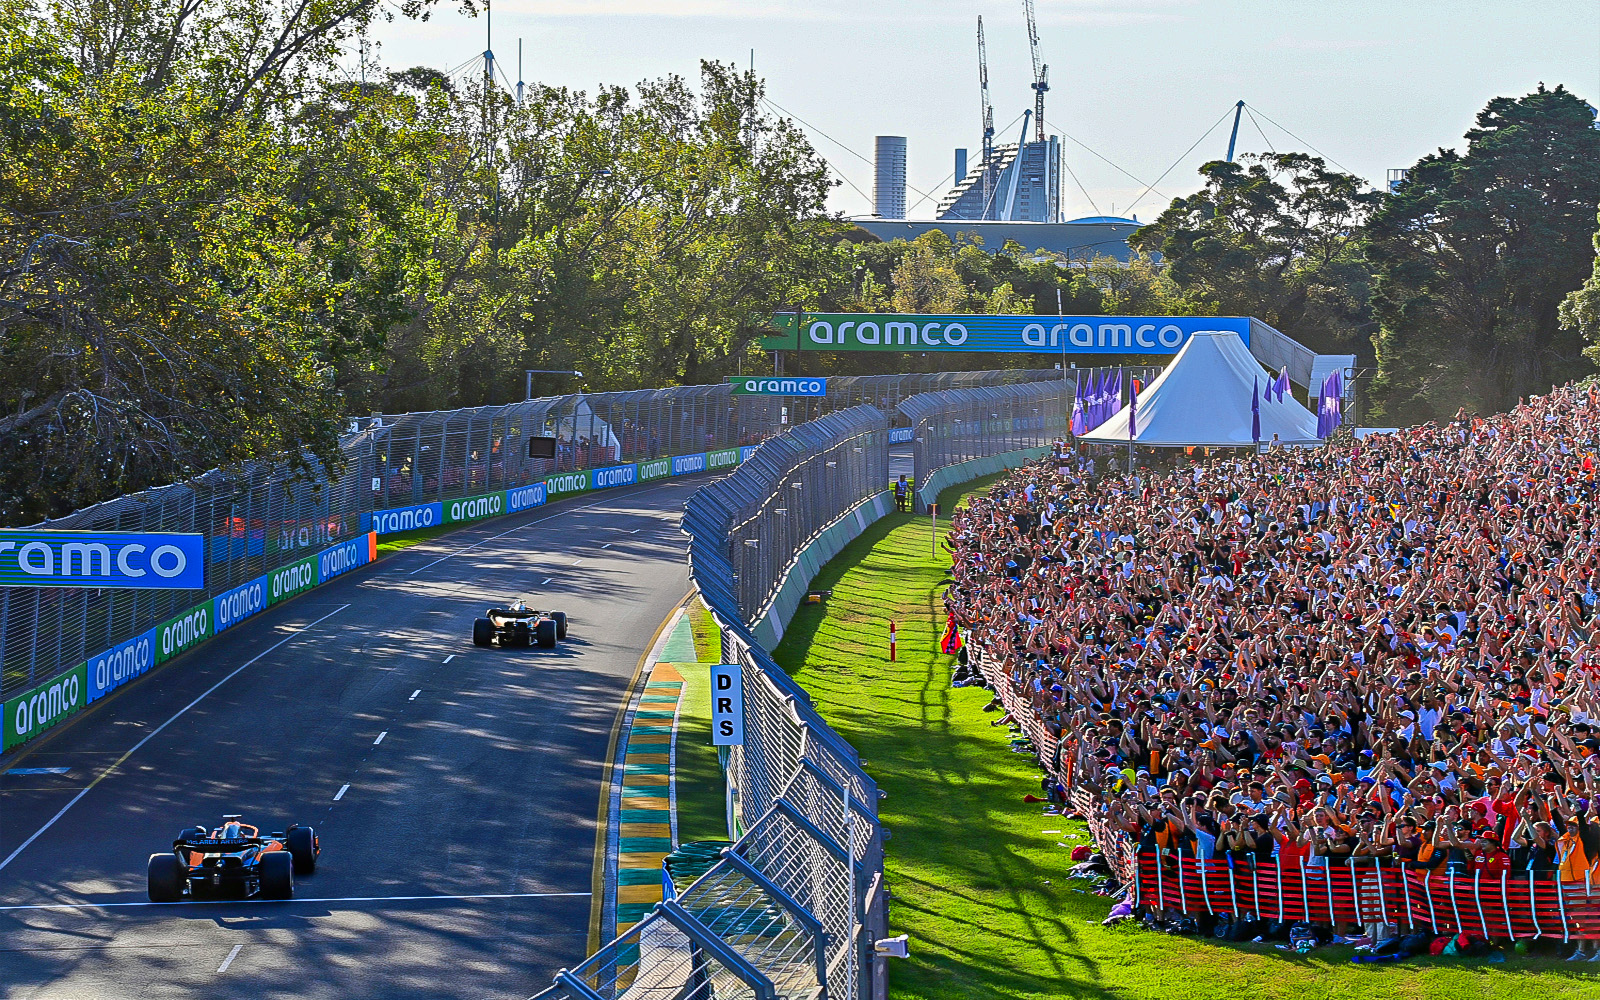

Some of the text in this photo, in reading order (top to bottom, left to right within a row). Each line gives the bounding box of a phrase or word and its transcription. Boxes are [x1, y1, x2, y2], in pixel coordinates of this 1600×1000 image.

[809, 321, 1184, 348] aramco aramco
[745, 380, 820, 393] aramco
[641, 461, 668, 479] aramco
[675, 456, 703, 473] aramco
[709, 450, 737, 467] aramco
[547, 474, 586, 494] aramco
[597, 467, 633, 486] aramco
[451, 495, 500, 520] aramco
[511, 486, 543, 509] aramco
[321, 543, 357, 577] aramco
[273, 562, 312, 598] aramco
[220, 583, 261, 624] aramco
[162, 608, 207, 655] aramco
[96, 637, 149, 690] aramco
[15, 674, 79, 735] aramco
[717, 674, 734, 737] DRS
